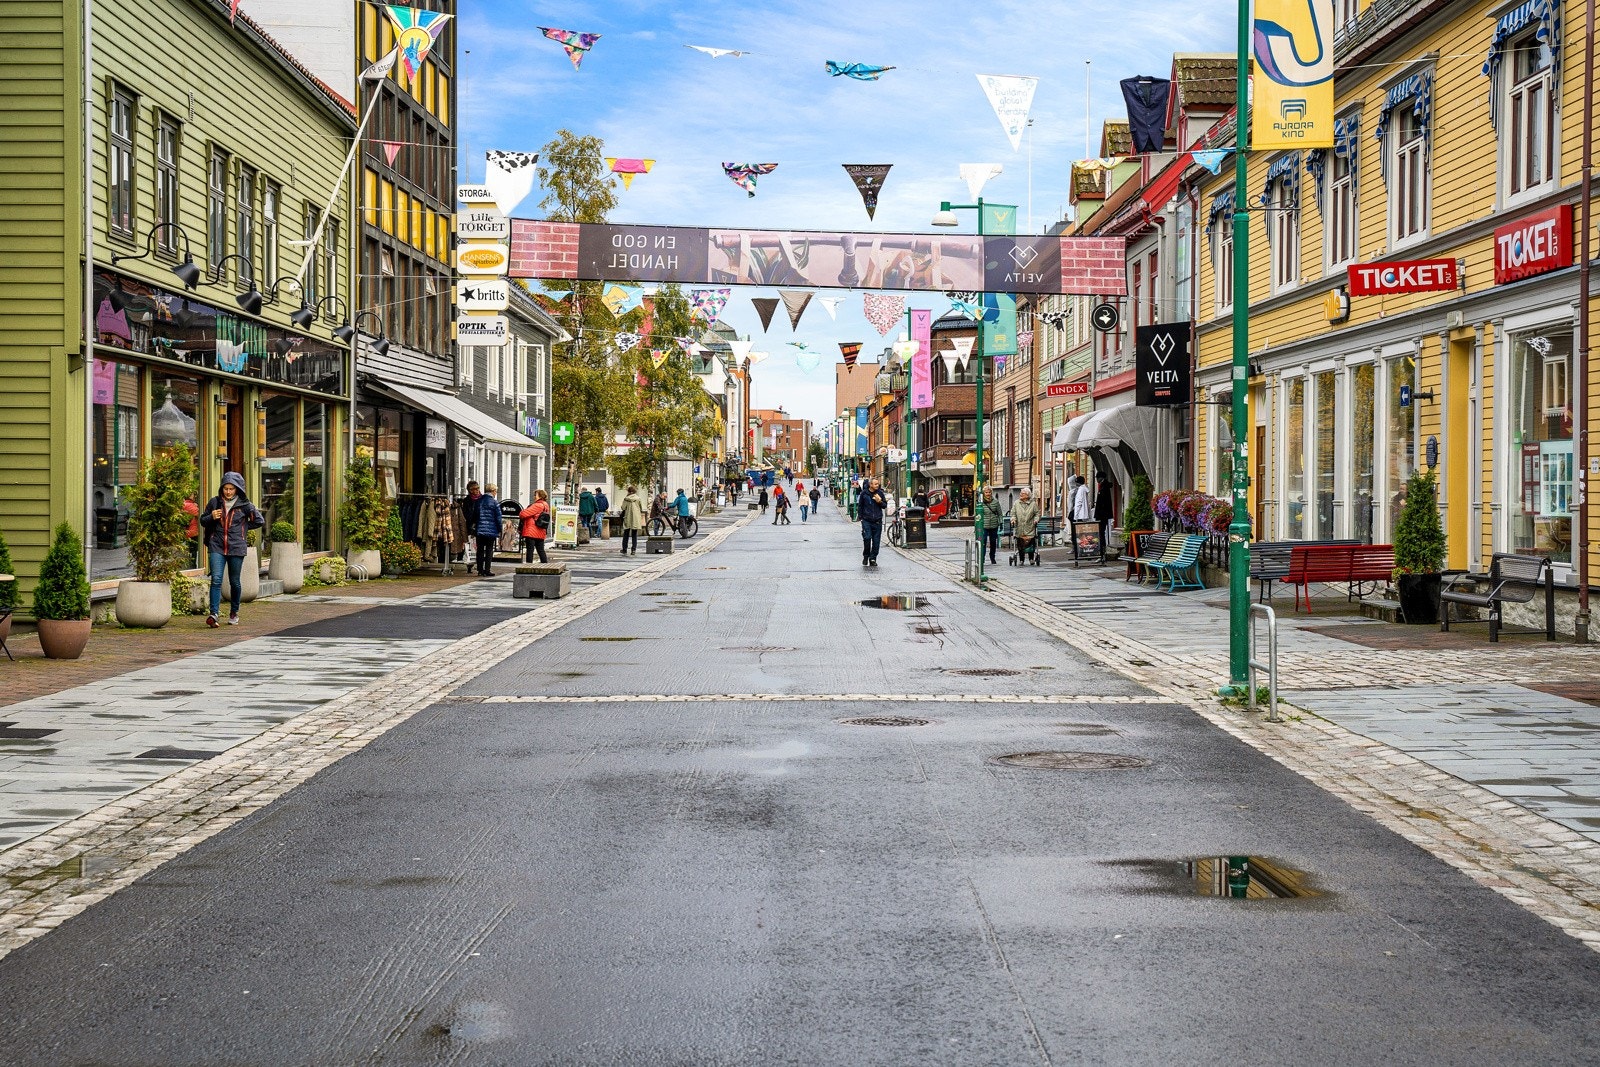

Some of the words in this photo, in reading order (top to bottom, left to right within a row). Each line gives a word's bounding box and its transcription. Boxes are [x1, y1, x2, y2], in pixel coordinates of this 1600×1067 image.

[1273, 121, 1315, 130] AURORA
[1281, 130, 1305, 138] KINO
[470, 212, 494, 222] Lille
[1498, 218, 1556, 271] TICKET
[463, 253, 501, 261] HANSENS
[1358, 264, 1449, 289] TICKET
[477, 287, 505, 301] britts
[459, 322, 487, 330] OPTIK
[1147, 370, 1179, 384] VEITA
[1050, 385, 1085, 395] LINDEX
